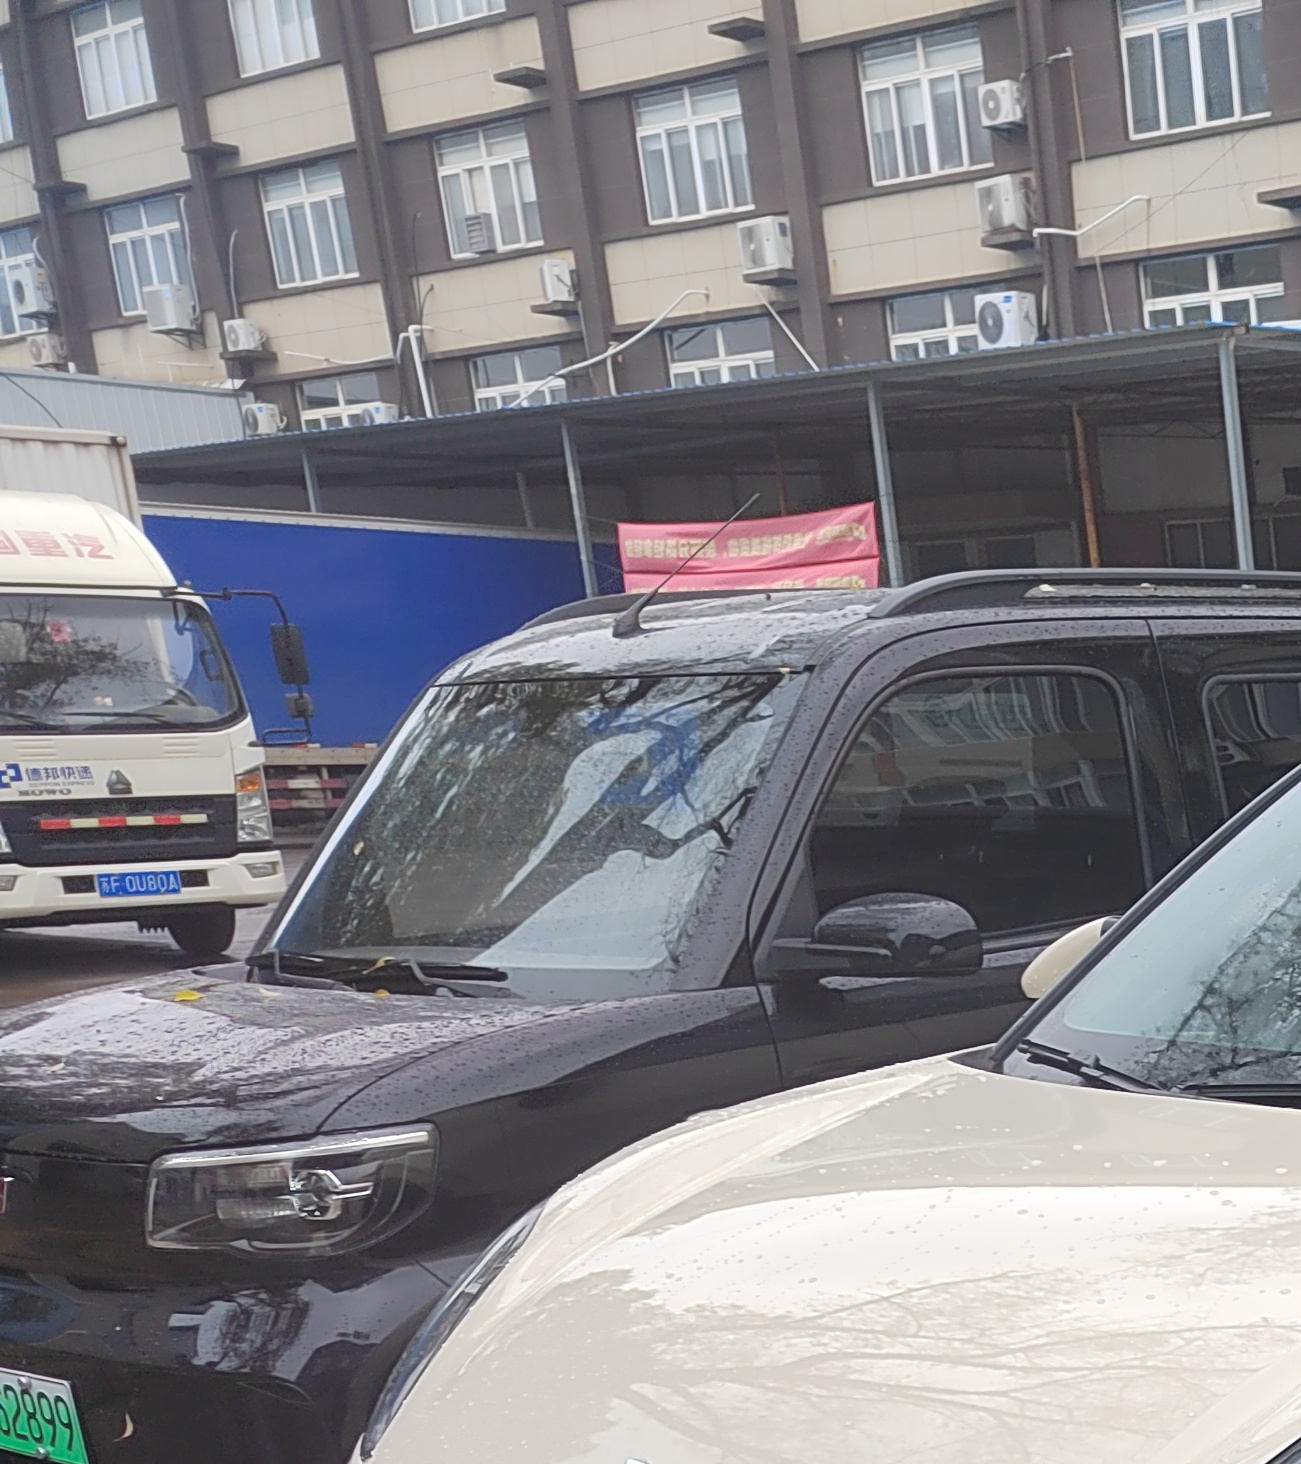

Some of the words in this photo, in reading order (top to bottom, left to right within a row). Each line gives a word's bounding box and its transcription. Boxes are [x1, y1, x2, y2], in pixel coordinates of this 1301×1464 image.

[25, 765, 94, 782] 德邦快递
[18, 787, 72, 797] HOWO
